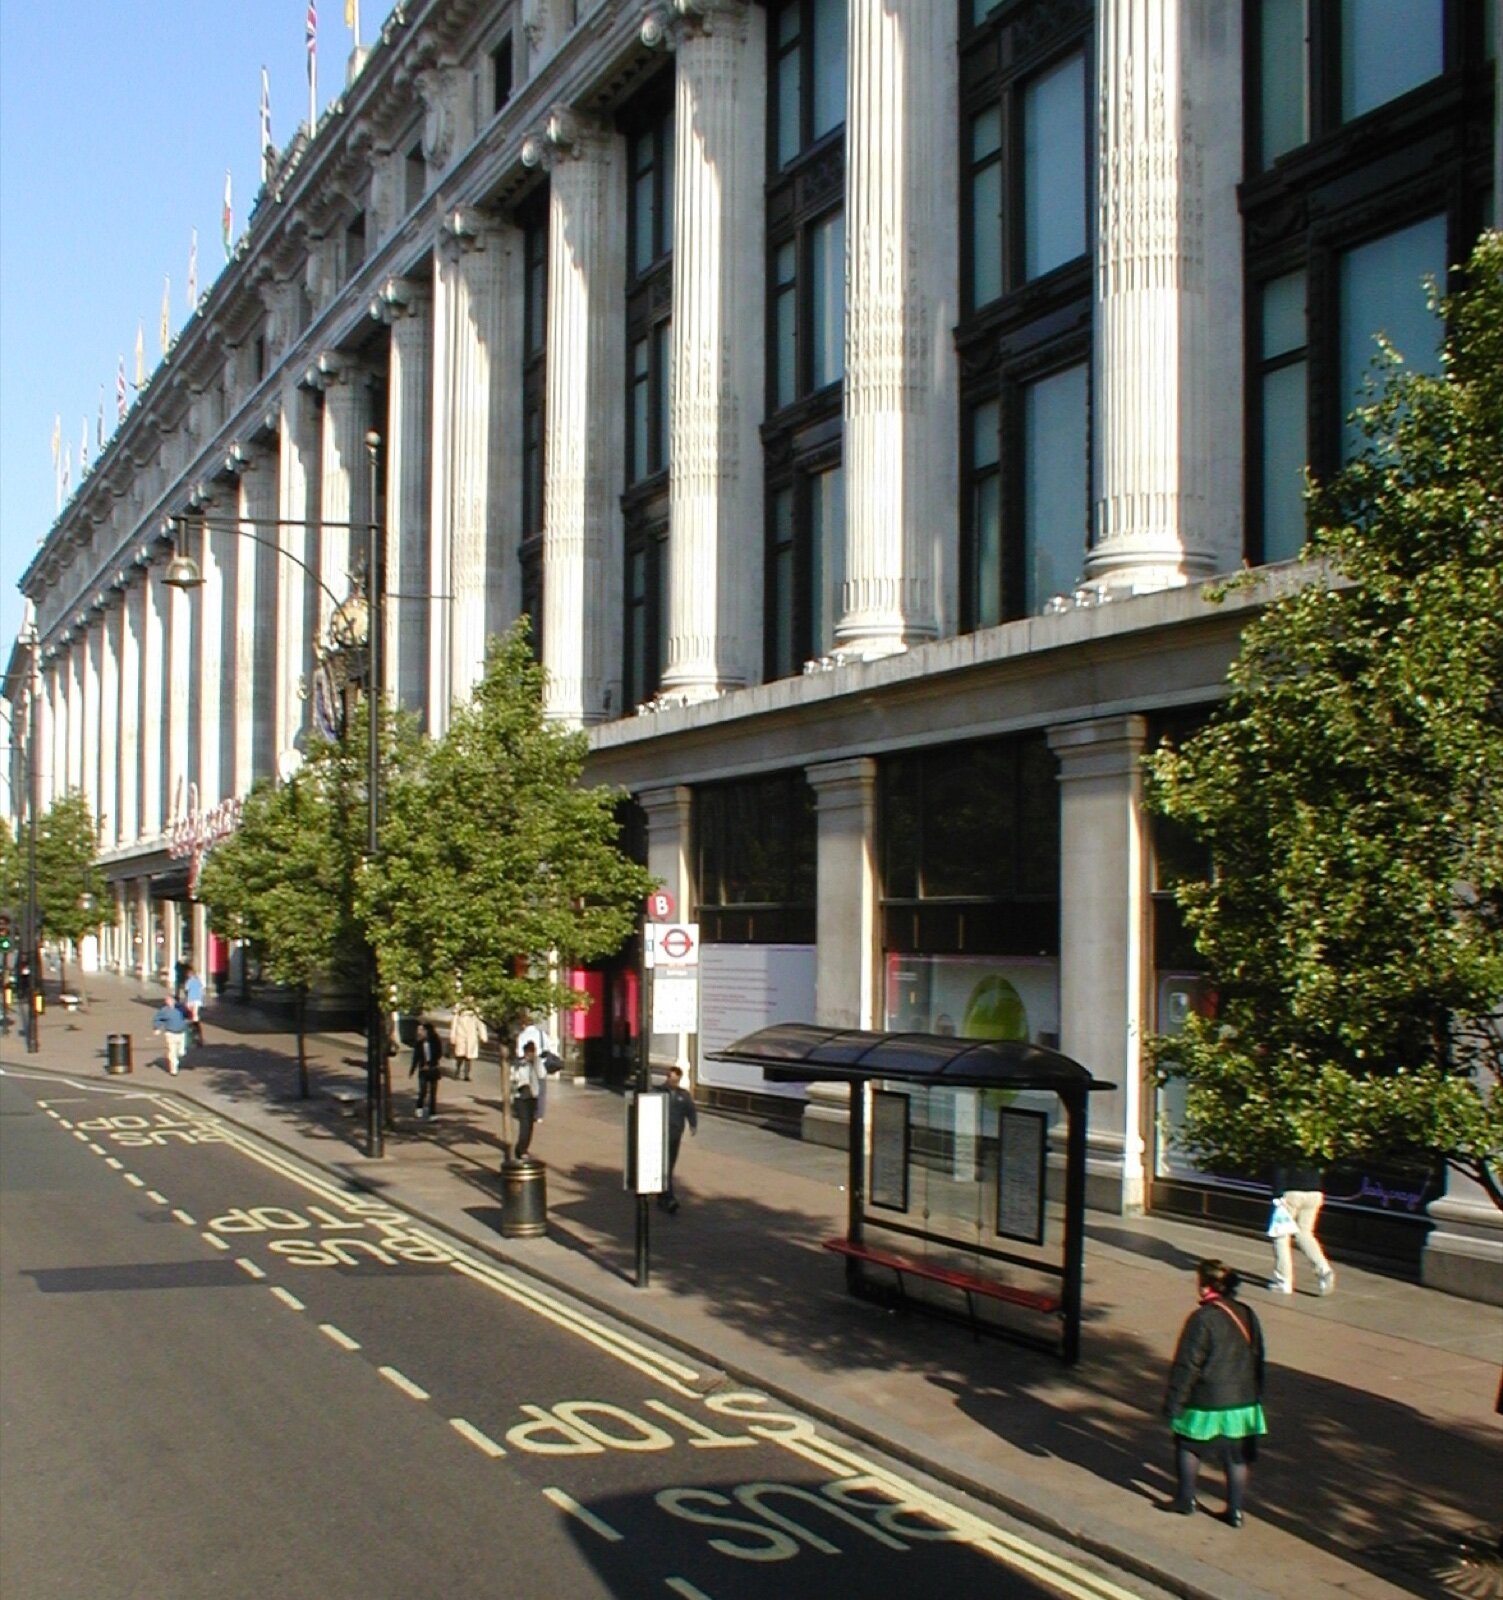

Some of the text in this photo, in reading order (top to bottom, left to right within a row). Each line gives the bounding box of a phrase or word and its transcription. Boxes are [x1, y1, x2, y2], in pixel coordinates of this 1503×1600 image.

[655, 896, 669, 916] B
[109, 1130, 229, 1146] BUS
[208, 1203, 410, 1233] STOP
[268, 1235, 456, 1266] BUS
[505, 1392, 816, 1454] STOP
[655, 1475, 963, 1562] BUS
